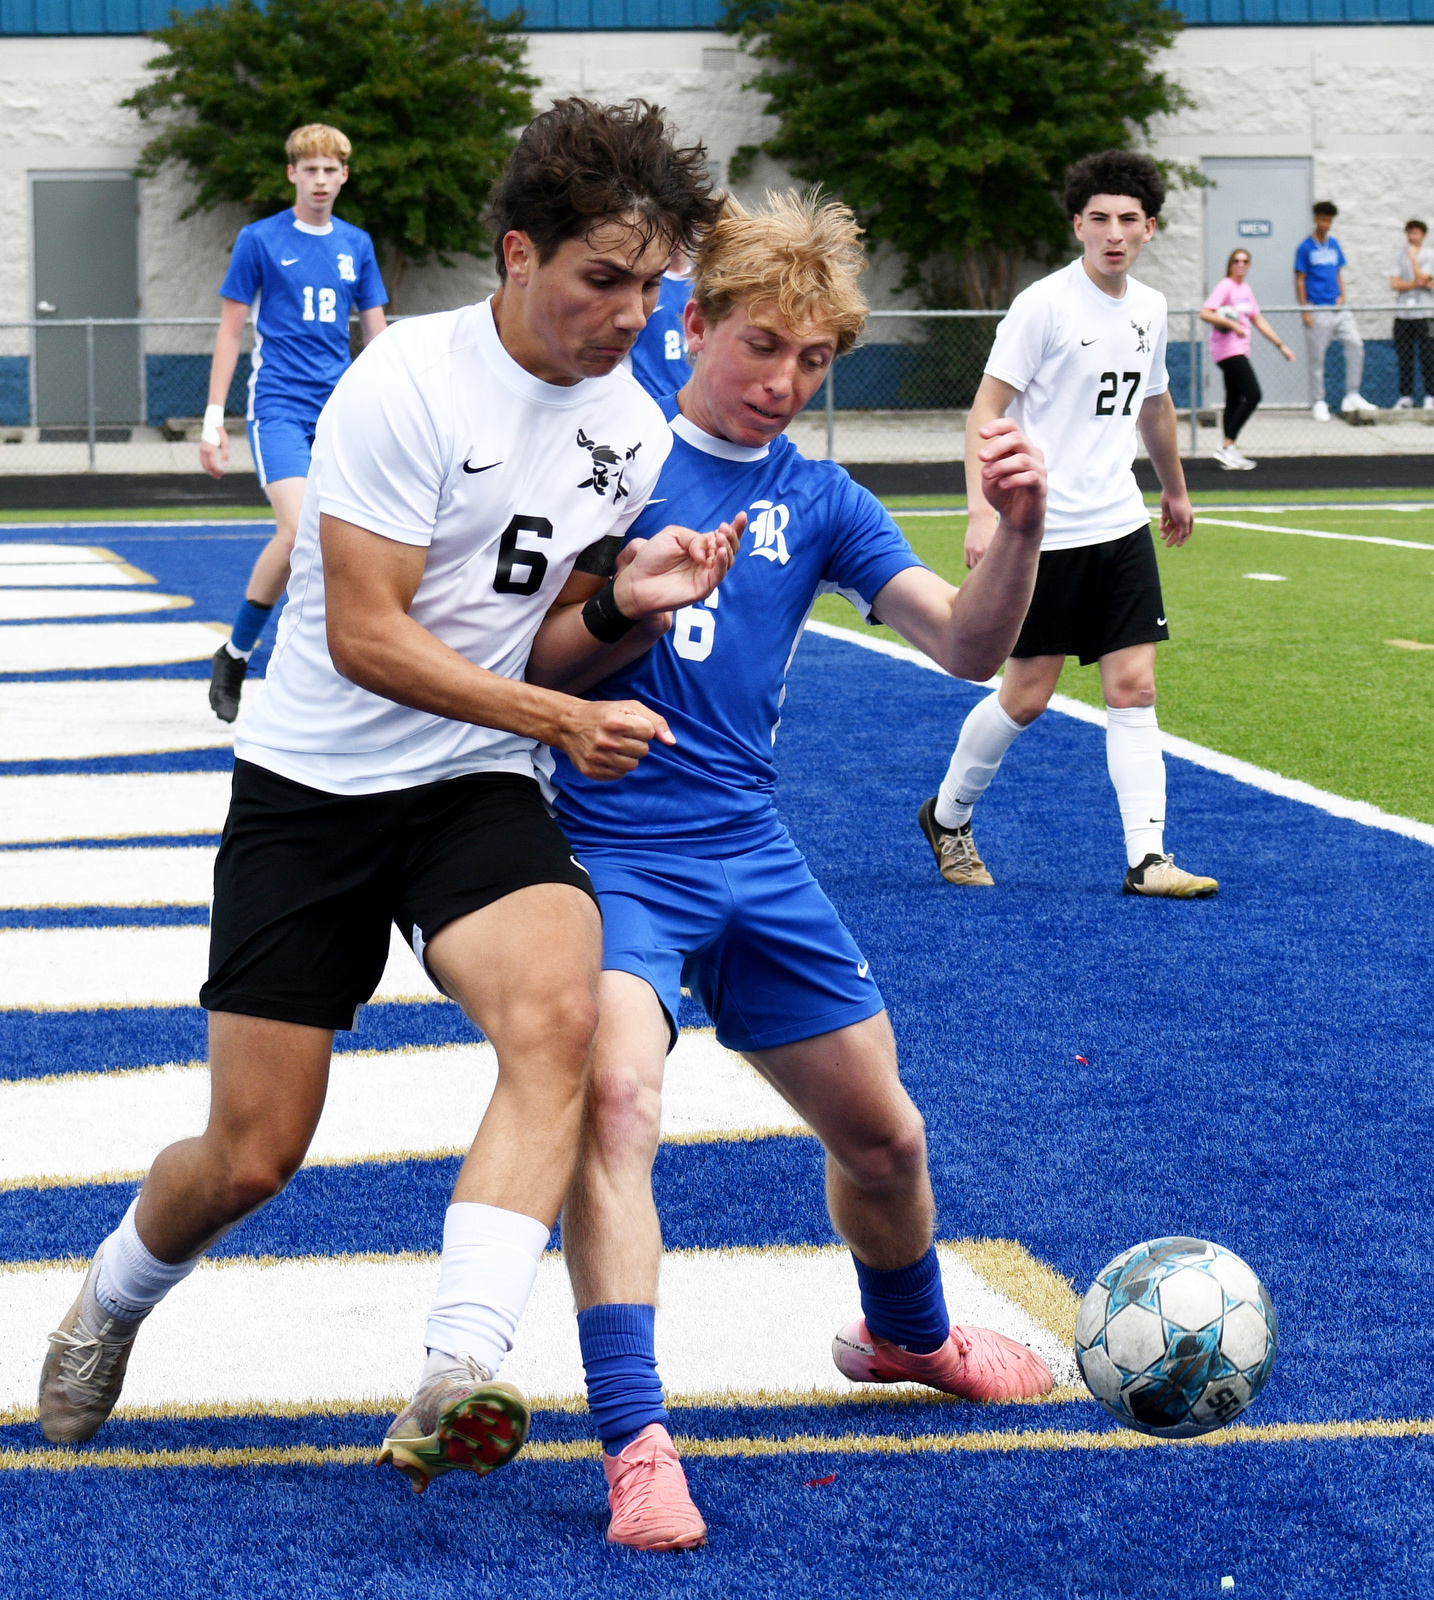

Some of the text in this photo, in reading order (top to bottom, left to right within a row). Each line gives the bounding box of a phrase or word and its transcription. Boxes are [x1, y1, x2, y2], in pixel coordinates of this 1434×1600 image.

[1242, 223, 1270, 235] MEN
[302, 286, 336, 323] 12
[1095, 371, 1141, 416] 27
[493, 513, 553, 597] 6
[749, 499, 791, 566] R
